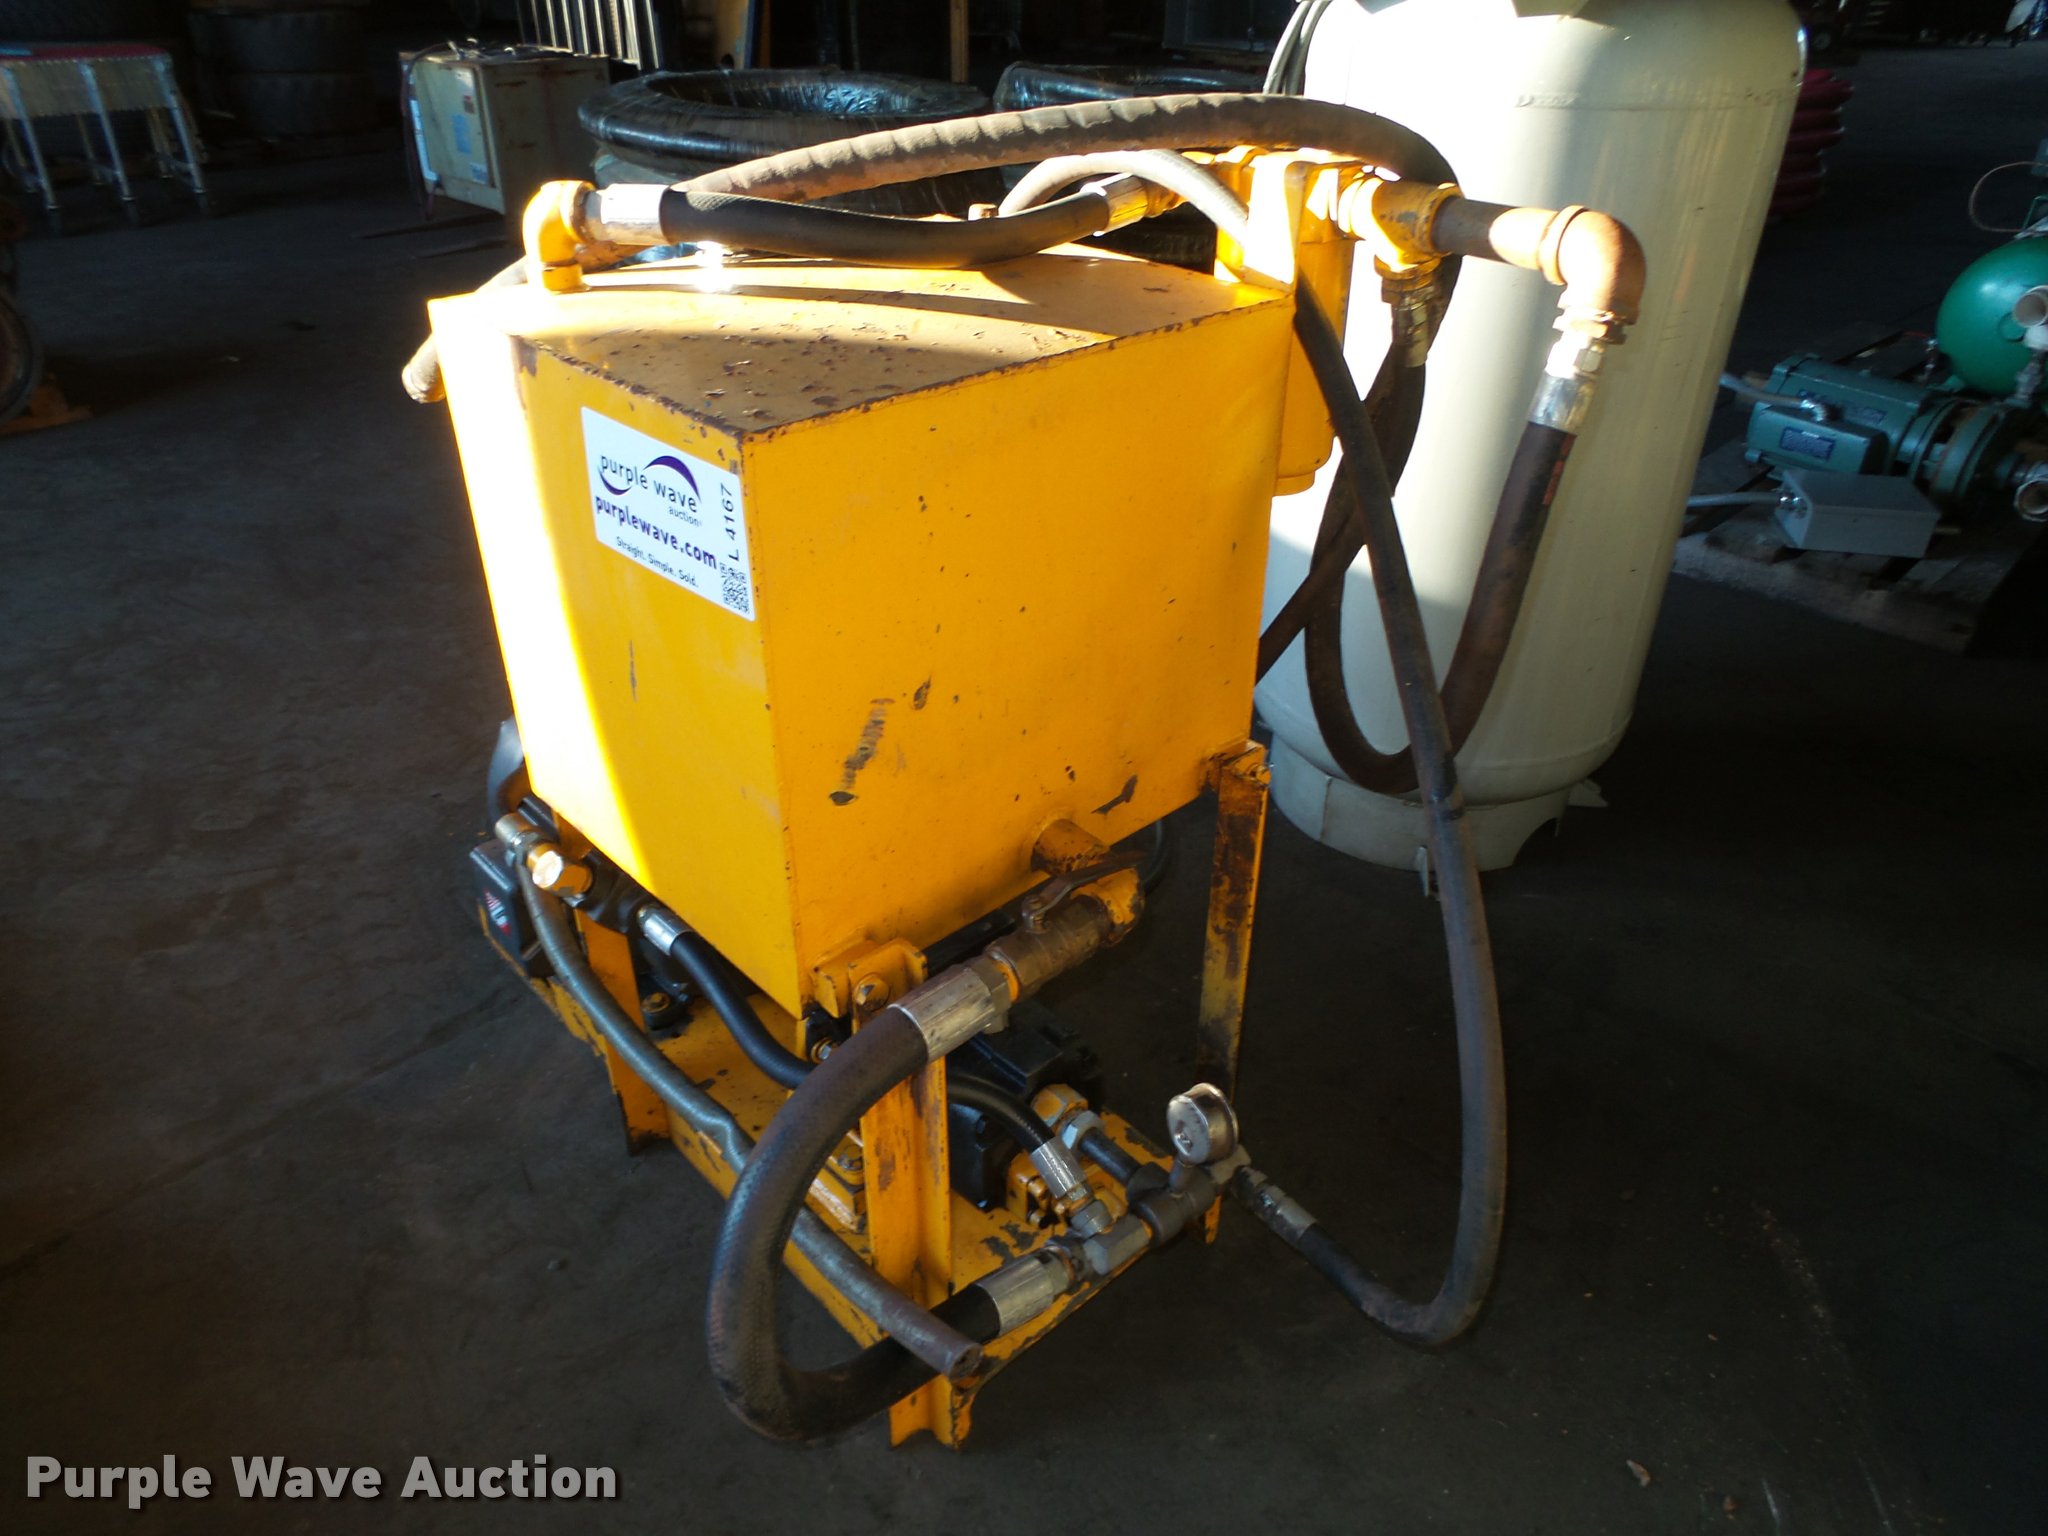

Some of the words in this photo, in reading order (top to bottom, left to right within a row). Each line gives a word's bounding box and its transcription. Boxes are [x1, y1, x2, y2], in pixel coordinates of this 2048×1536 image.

[600, 455, 648, 489] purple
[653, 480, 697, 513] wave
[595, 496, 717, 570] purplewave.com
[668, 506, 699, 527] auction
[616, 536, 646, 559] Straight.
[648, 553, 677, 576] Simple.
[678, 569, 699, 588] Sold.
